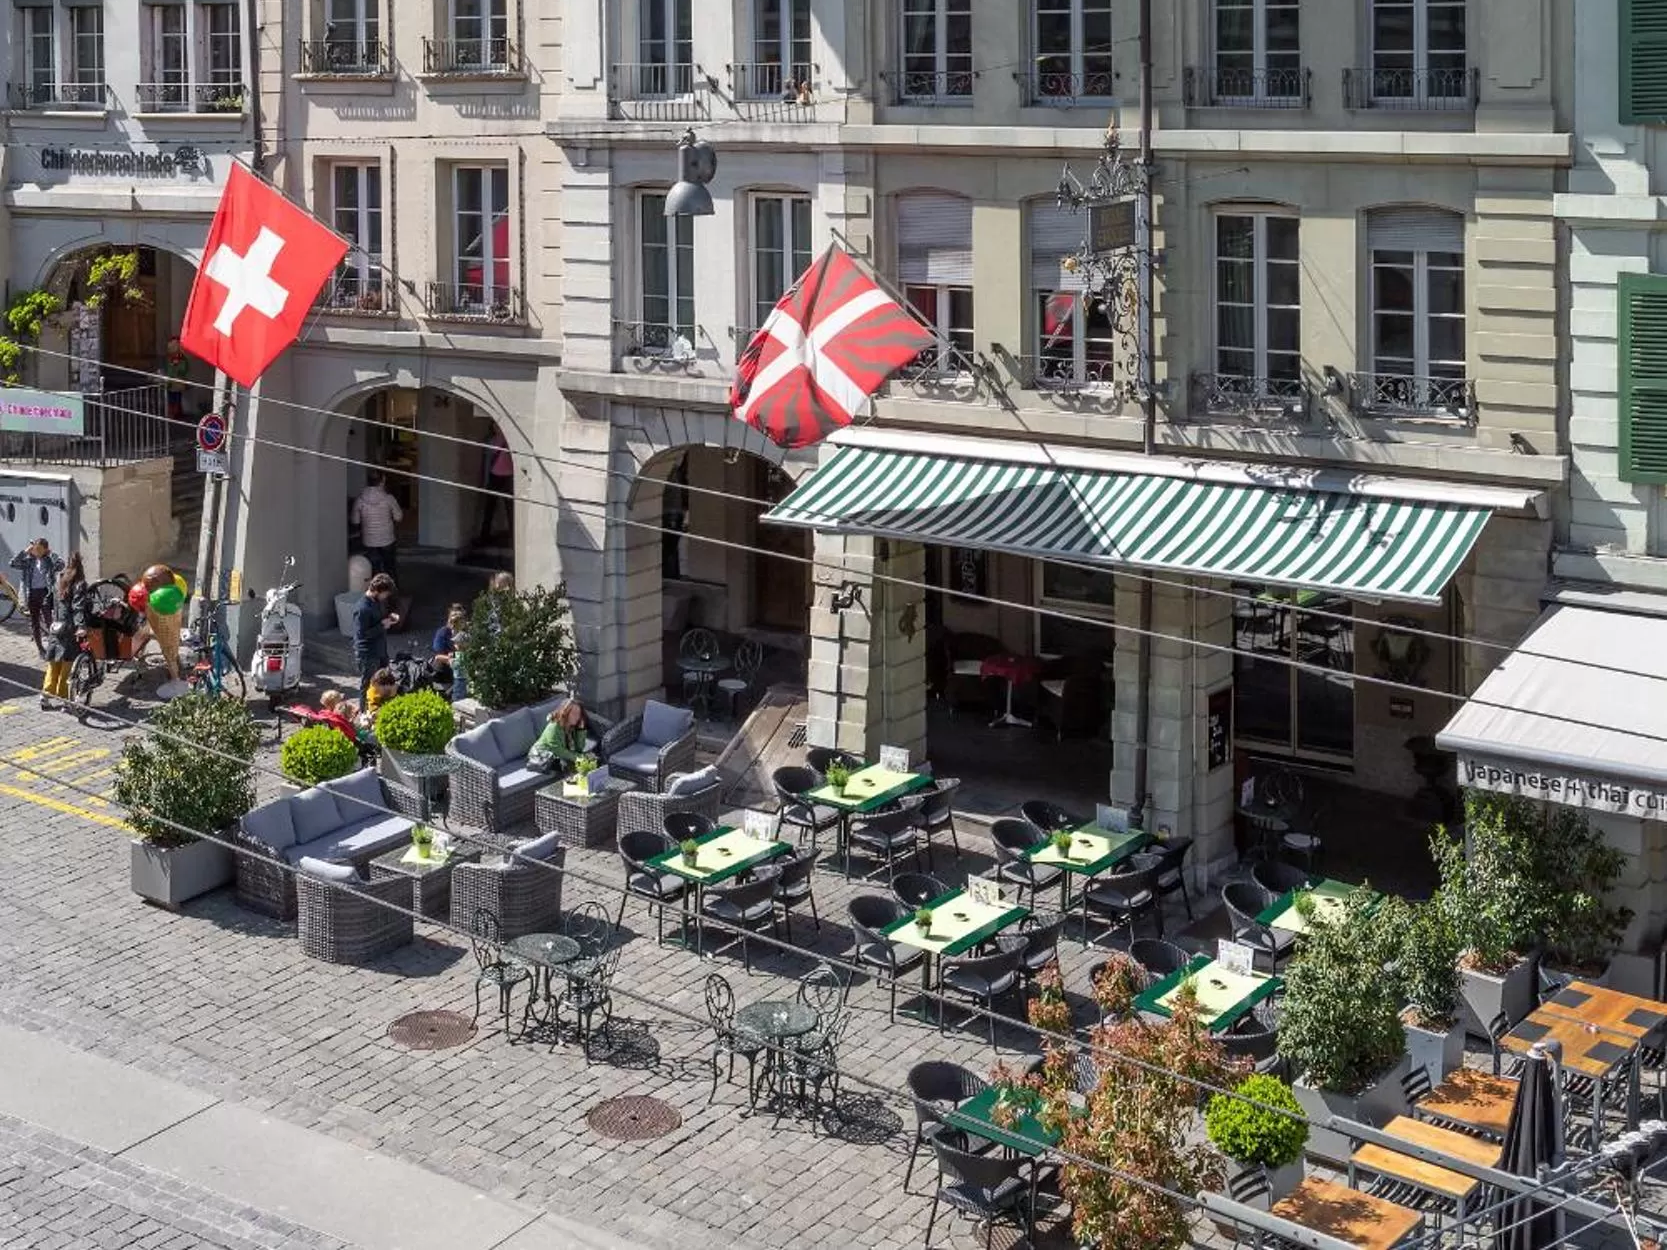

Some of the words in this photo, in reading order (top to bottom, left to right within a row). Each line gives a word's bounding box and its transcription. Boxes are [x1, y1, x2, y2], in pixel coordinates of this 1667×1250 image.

[1468, 760, 1561, 793] japanese
[1587, 781, 1629, 804] thai
[1634, 791, 1667, 812] cui
